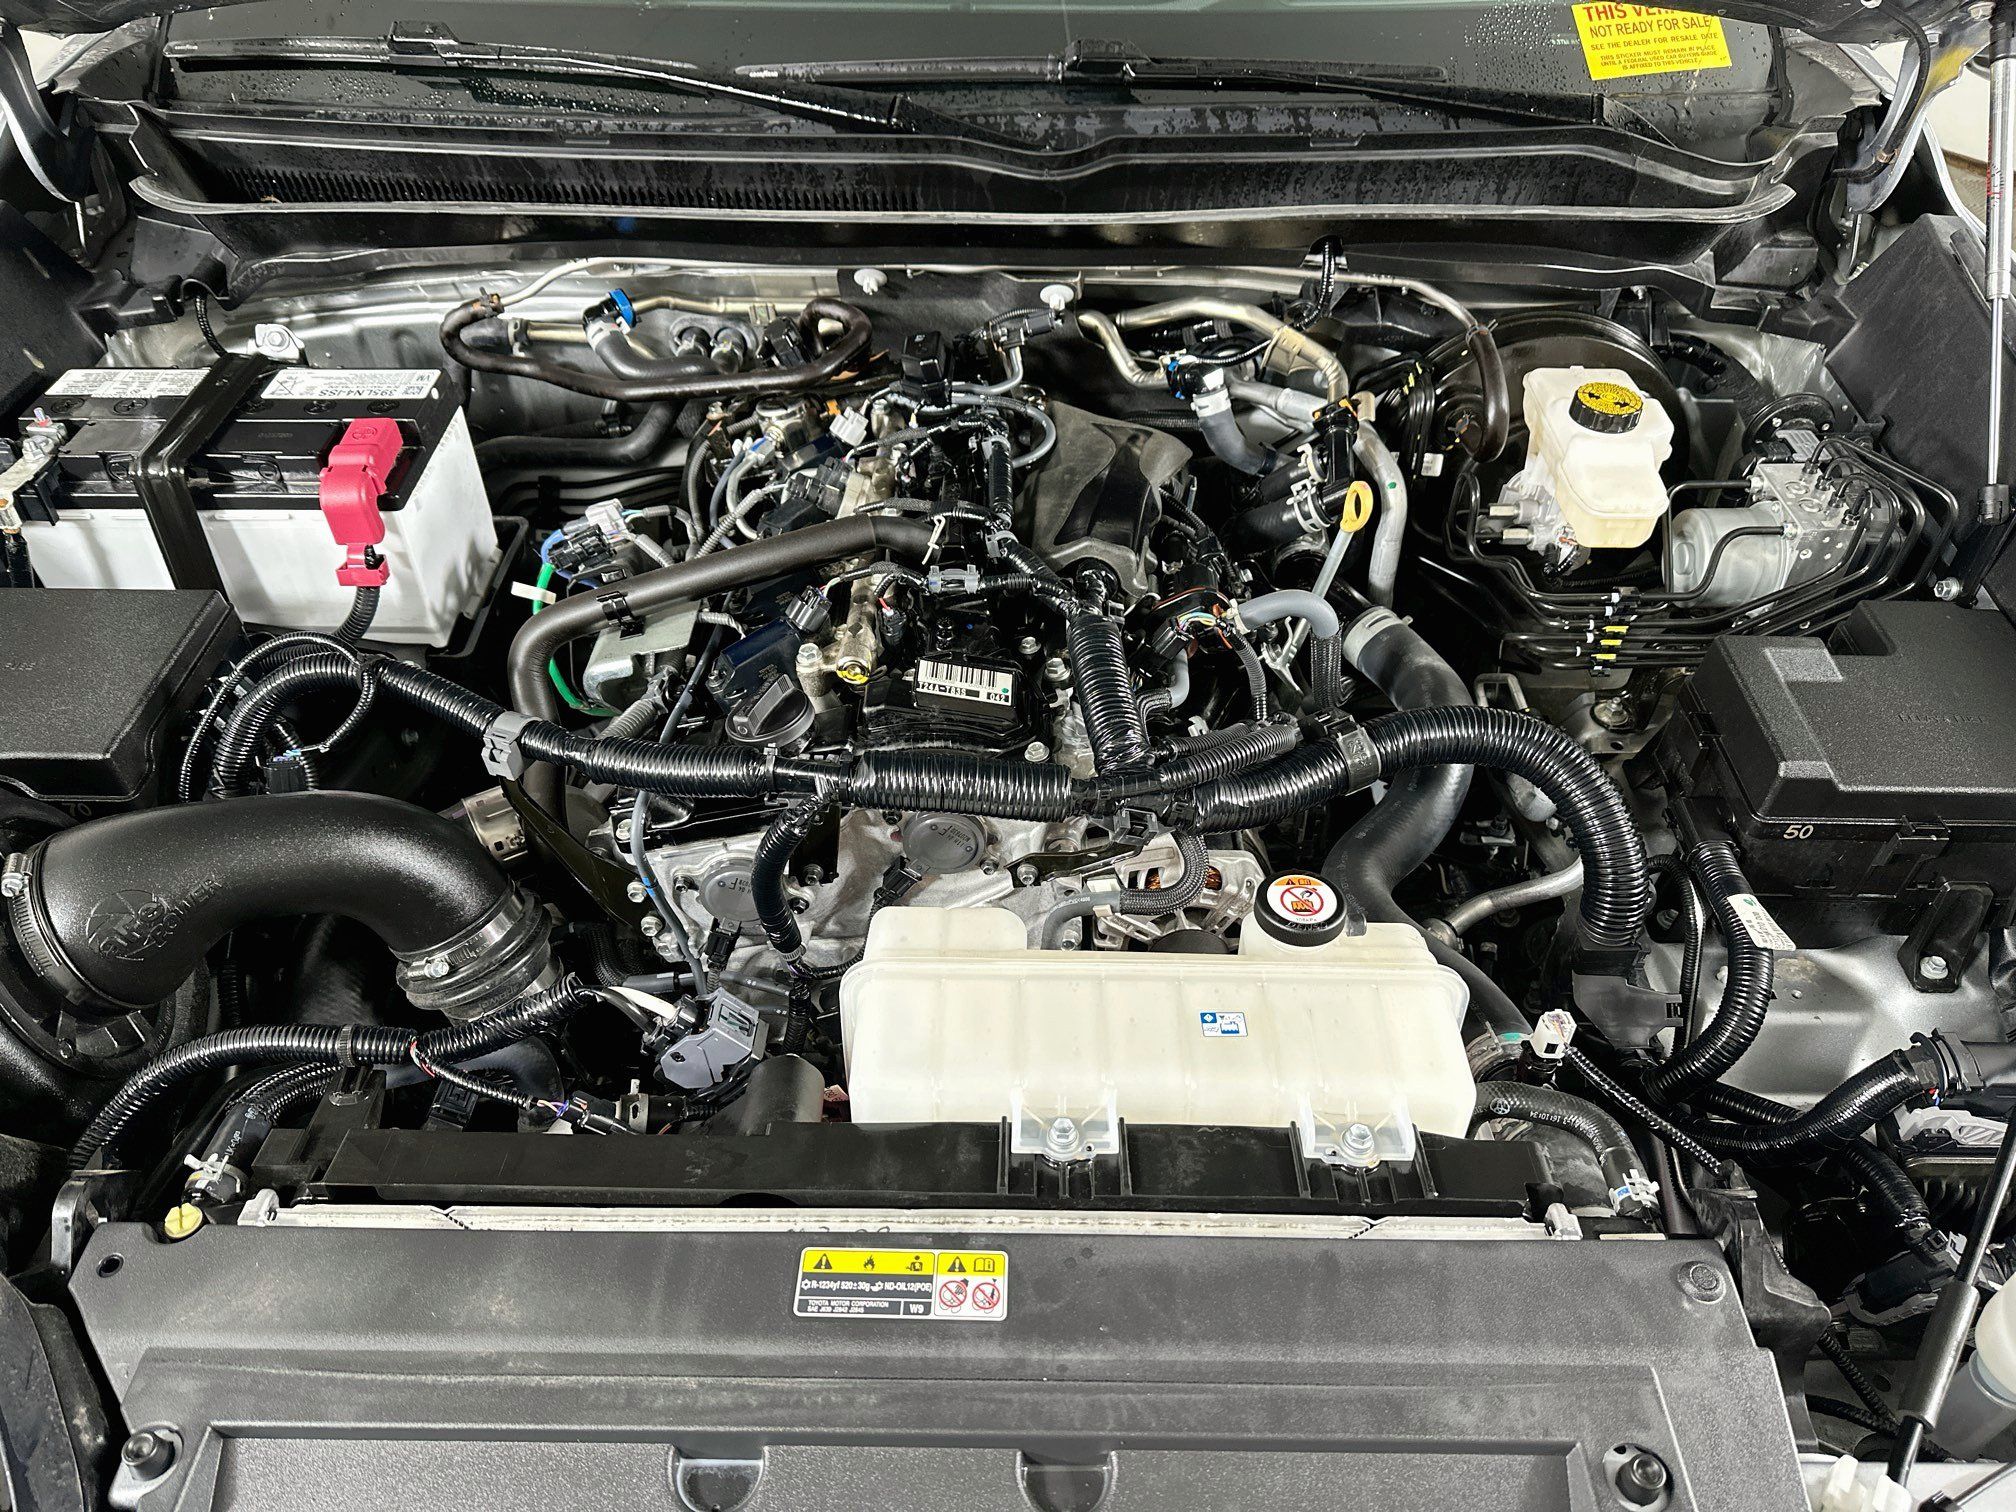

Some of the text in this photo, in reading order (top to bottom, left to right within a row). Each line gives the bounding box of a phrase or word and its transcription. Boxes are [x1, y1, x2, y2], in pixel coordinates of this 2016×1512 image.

[1583, 4, 1627, 22] THIS
[1590, 16, 1711, 38] NOT READY FOR SALE
[1591, 43, 1605, 51] SEE
[1607, 41, 1622, 49] THE
[1623, 39, 1651, 47] DEALER
[1670, 34, 1698, 42] RESALE
[1701, 32, 1718, 40] DATE
[1783, 824, 1814, 839] 50
[808, 1299, 829, 1307] TOYOTA
[909, 1303, 925, 1314] W9
